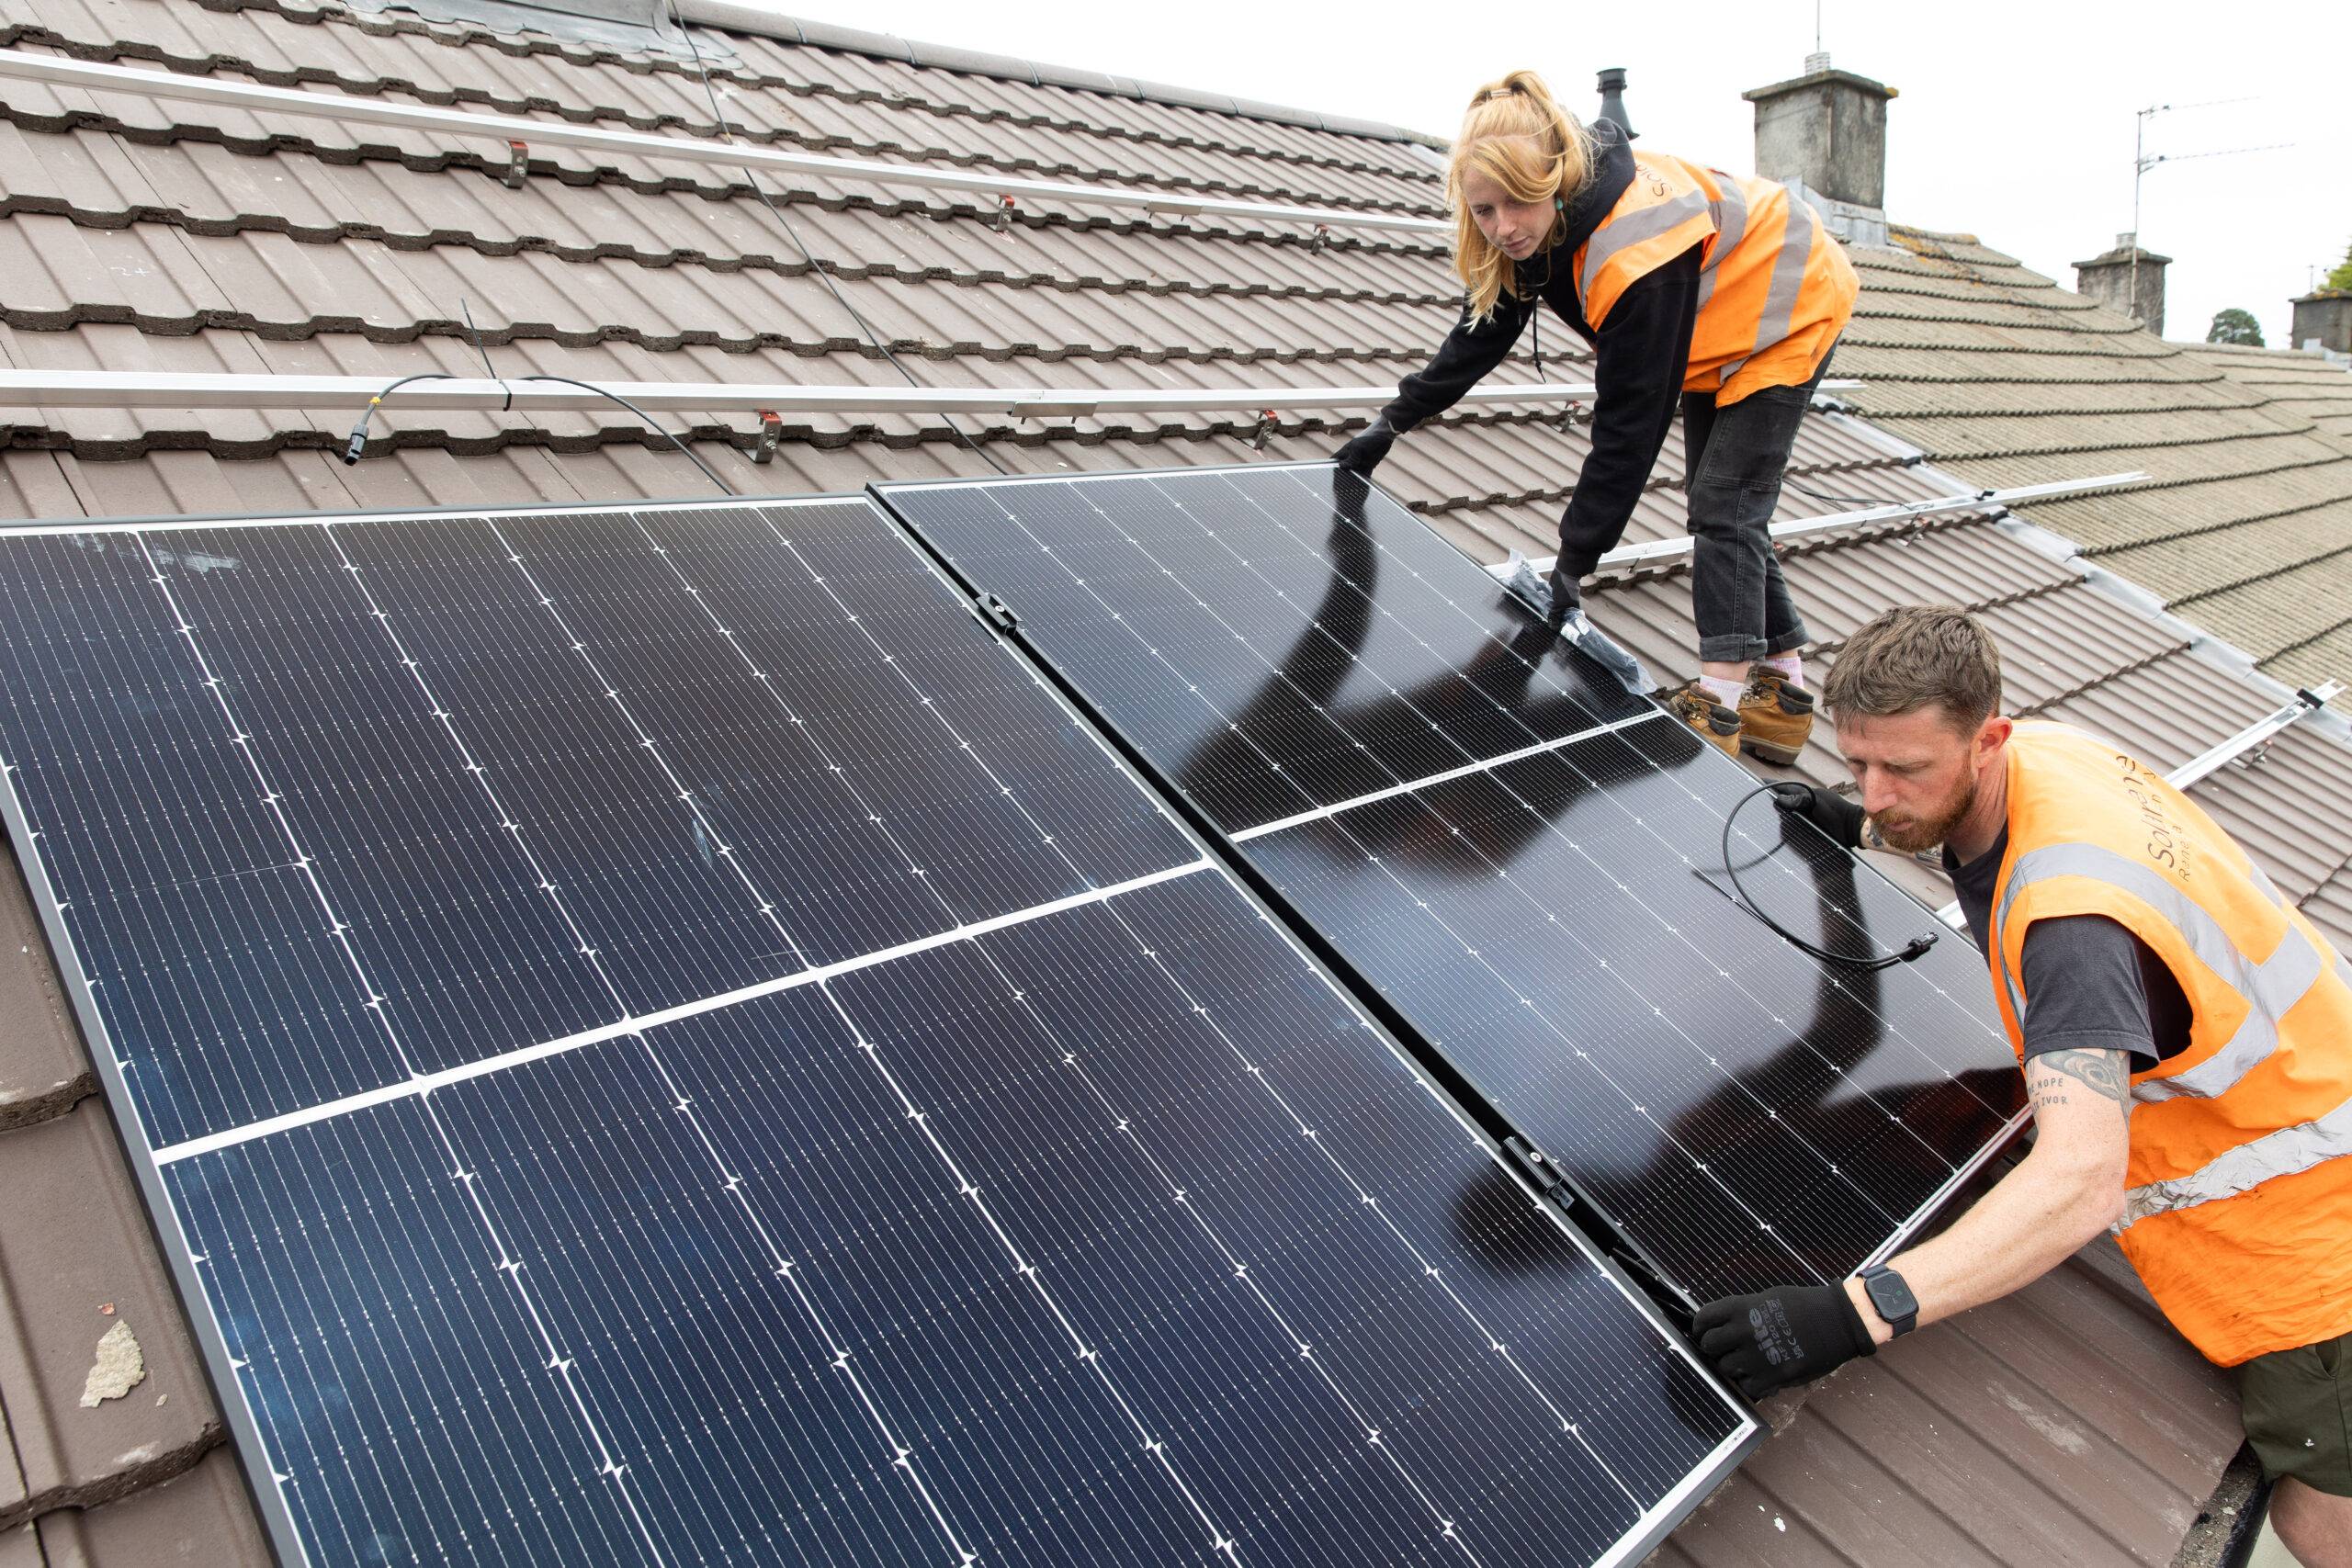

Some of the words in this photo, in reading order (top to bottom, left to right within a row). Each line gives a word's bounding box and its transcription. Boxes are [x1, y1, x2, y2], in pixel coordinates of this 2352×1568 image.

[2037, 1077, 2064, 1089] HOPE
[2041, 1096, 2067, 1106] IVOR
[1749, 1308, 1781, 1366] site
